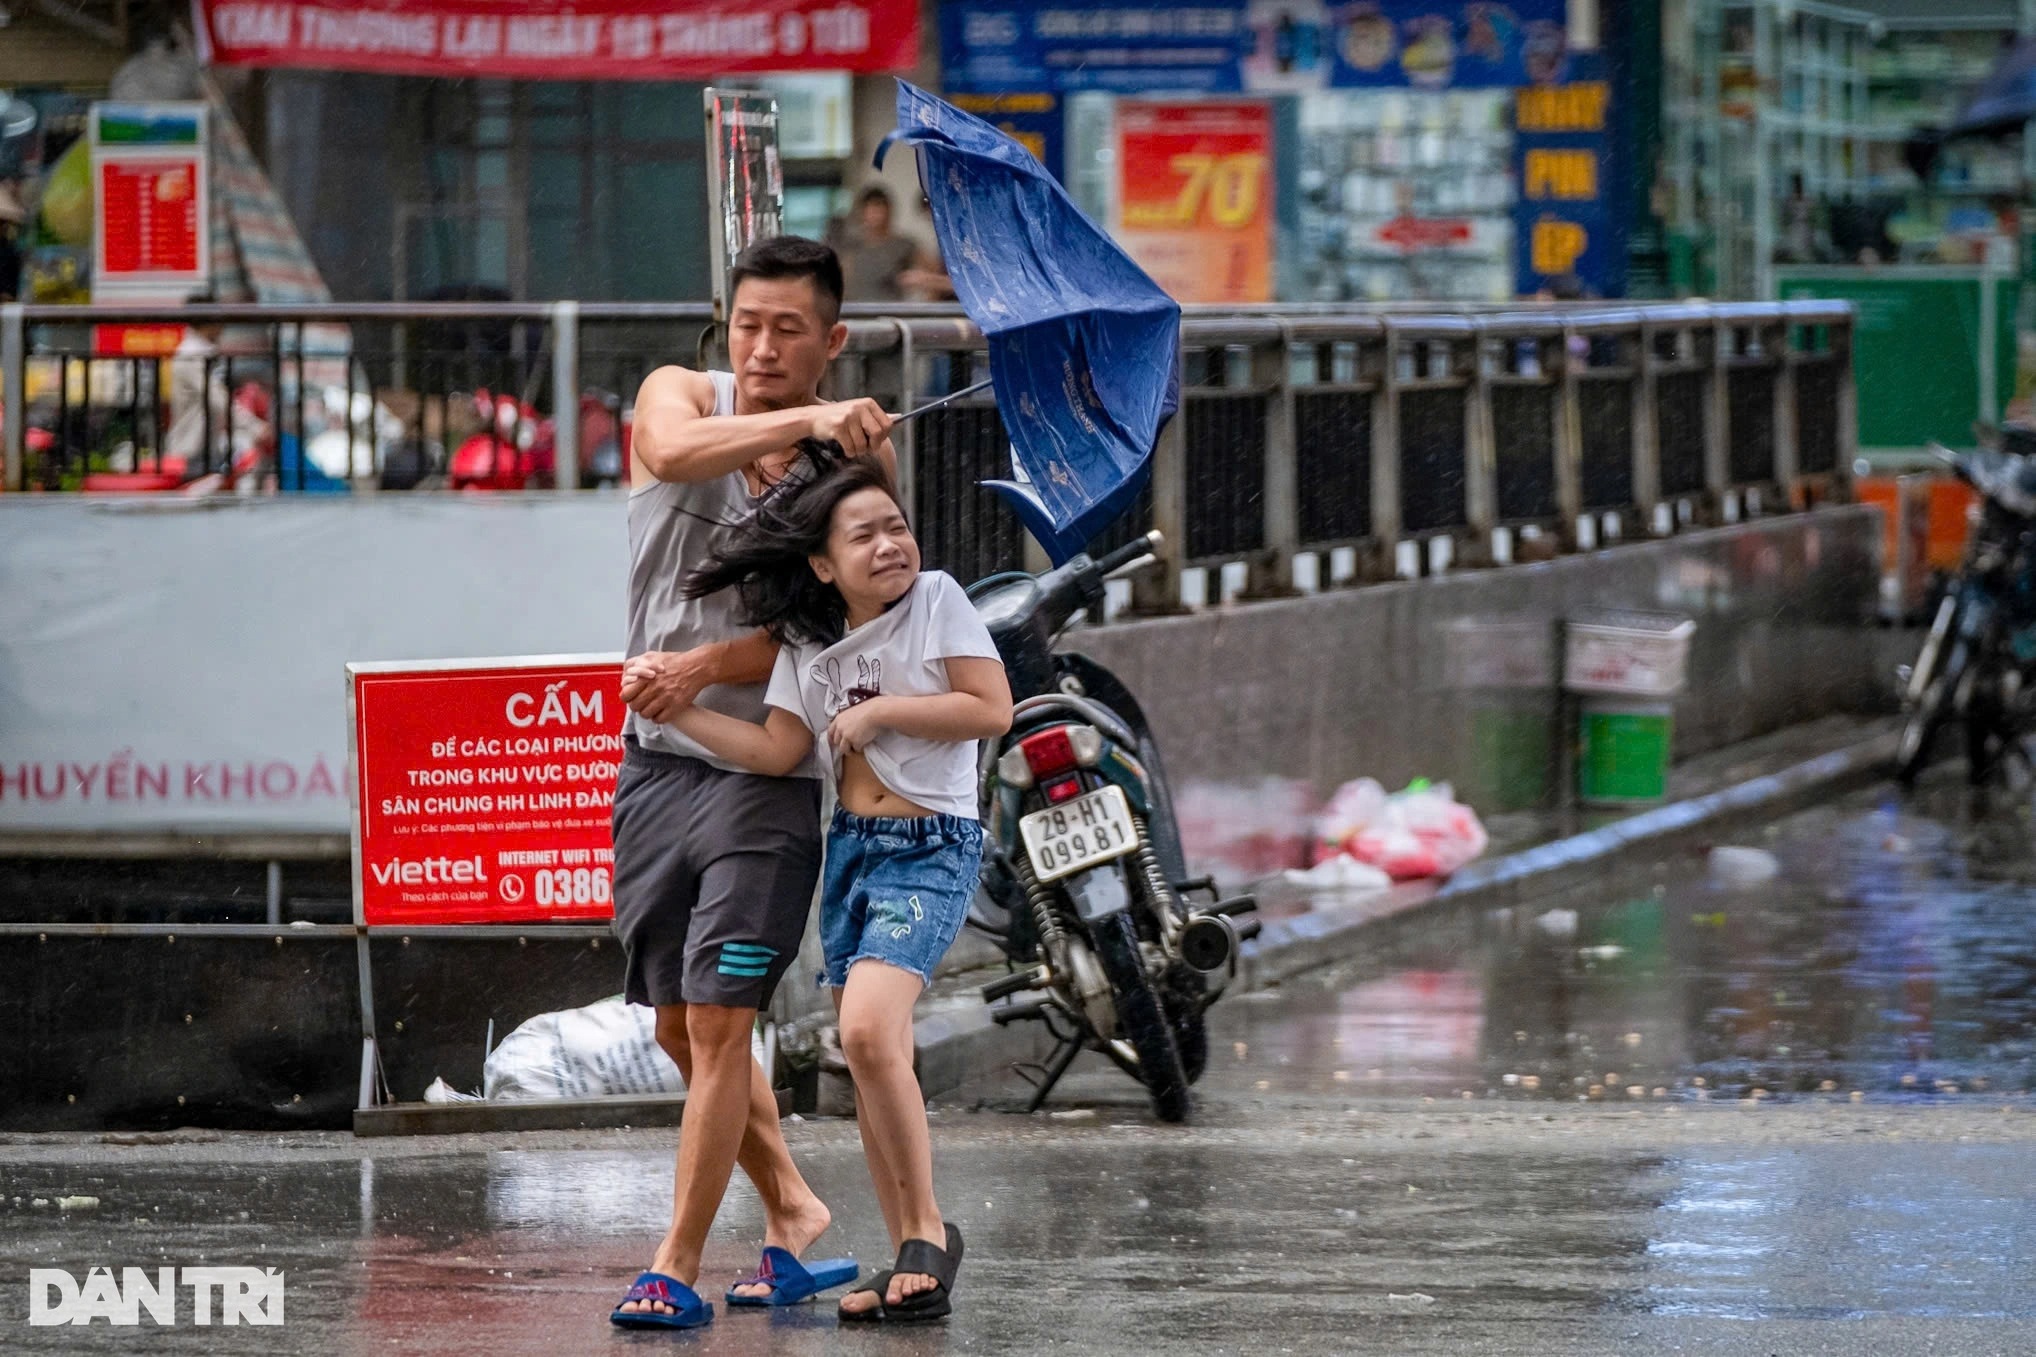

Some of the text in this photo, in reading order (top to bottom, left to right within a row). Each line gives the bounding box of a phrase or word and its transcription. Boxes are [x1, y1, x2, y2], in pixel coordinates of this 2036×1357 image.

[505, 680, 604, 728] CẤM
[431, 735, 458, 758] ĐỂ
[461, 737, 500, 757] CÁC
[505, 737, 549, 756] LOẠI
[408, 768, 474, 787] TRONG
[478, 766, 518, 785] KHU
[522, 763, 562, 785] VỰC
[382, 787, 616, 816] SÂN CHUNG HH LINH ĐÀM
[498, 850, 558, 866] INTERNET
[561, 848, 591, 864] WIFI
[1040, 820, 1126, 870] 099.81
[371, 855, 488, 885] viettel
[402, 889, 489, 903] Theo cách của bạn
